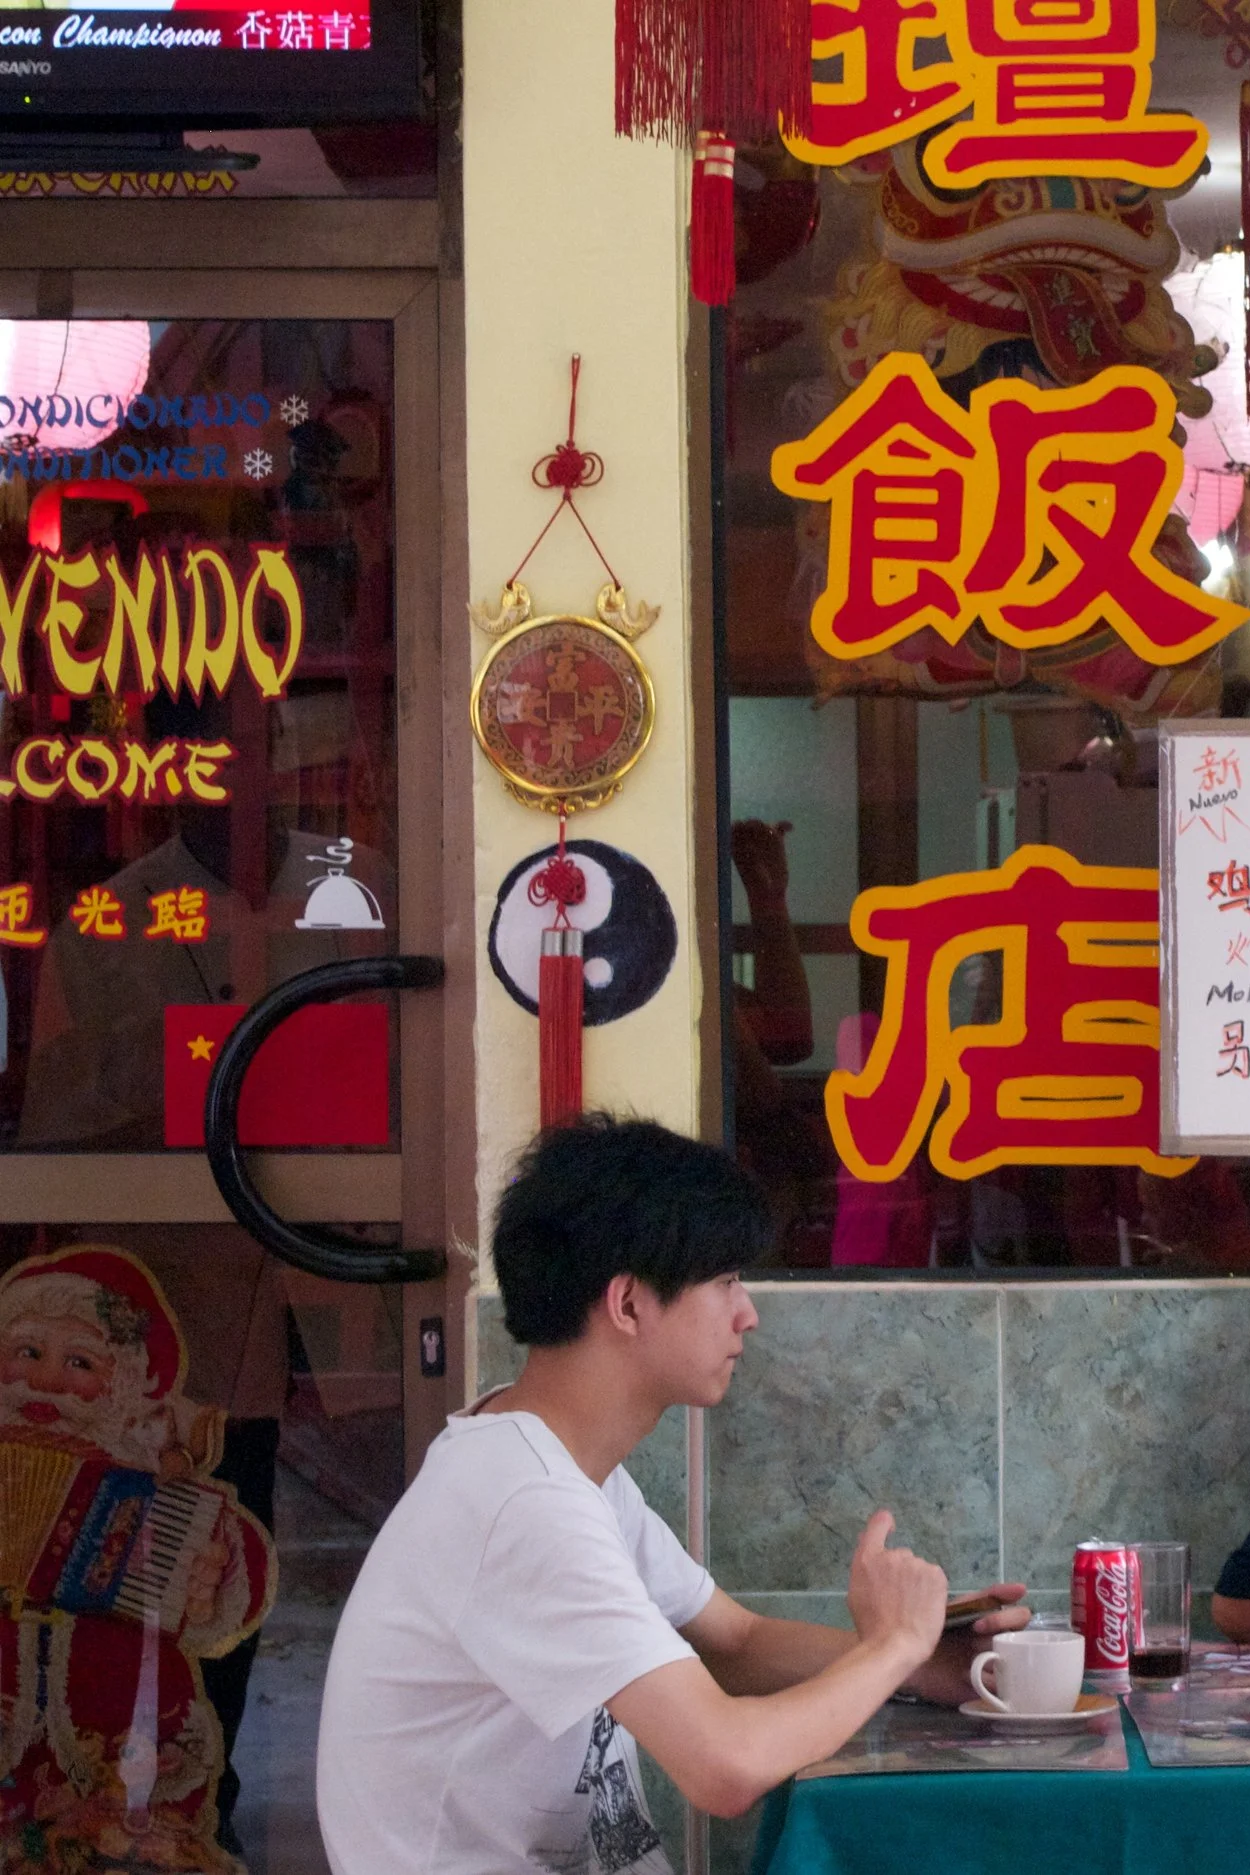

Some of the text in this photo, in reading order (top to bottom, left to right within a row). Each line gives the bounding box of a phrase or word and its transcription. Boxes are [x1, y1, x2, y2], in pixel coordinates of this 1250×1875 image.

[53, 14, 222, 49] Champignon
[234, 10, 370, 49] 香菇青
[0, 60, 52, 76] SANYO
[0, 443, 229, 482] NDITIONER
[1193, 745, 1242, 792] 新
[1189, 788, 1239, 812] Nuevo
